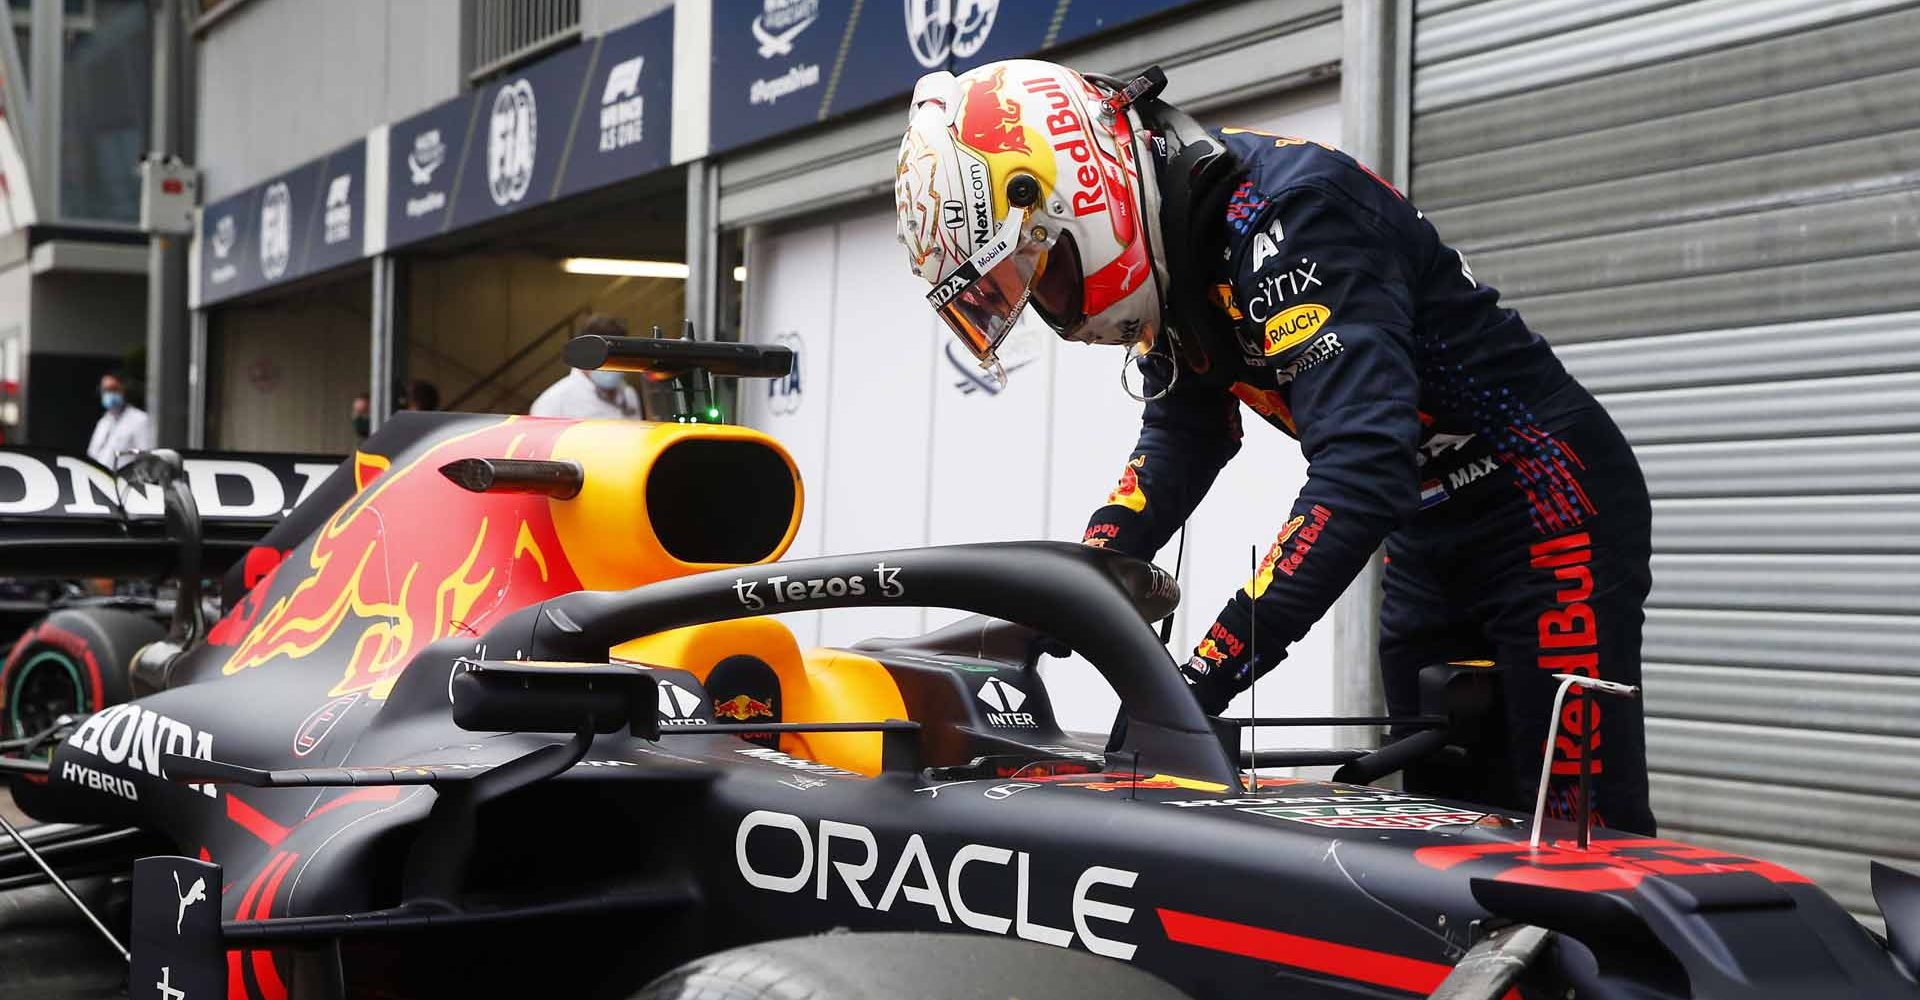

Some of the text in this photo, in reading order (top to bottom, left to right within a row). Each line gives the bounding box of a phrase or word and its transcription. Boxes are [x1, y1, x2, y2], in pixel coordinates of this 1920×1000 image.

[1022, 77, 1107, 218] Red Bull
[970, 163, 990, 249] Next.com
[978, 247, 999, 268] Mobil
[1249, 258, 1322, 323] citrix
[1269, 309, 1320, 345] RAUCH
[1448, 455, 1499, 490] MAX
[1277, 504, 1333, 577] Red Bull
[767, 575, 866, 603] Tezos
[1529, 532, 1597, 648] Bull
[987, 713, 1036, 726] INTER
[62, 761, 138, 801] HYBRID
[735, 810, 1139, 961] ORACLE
